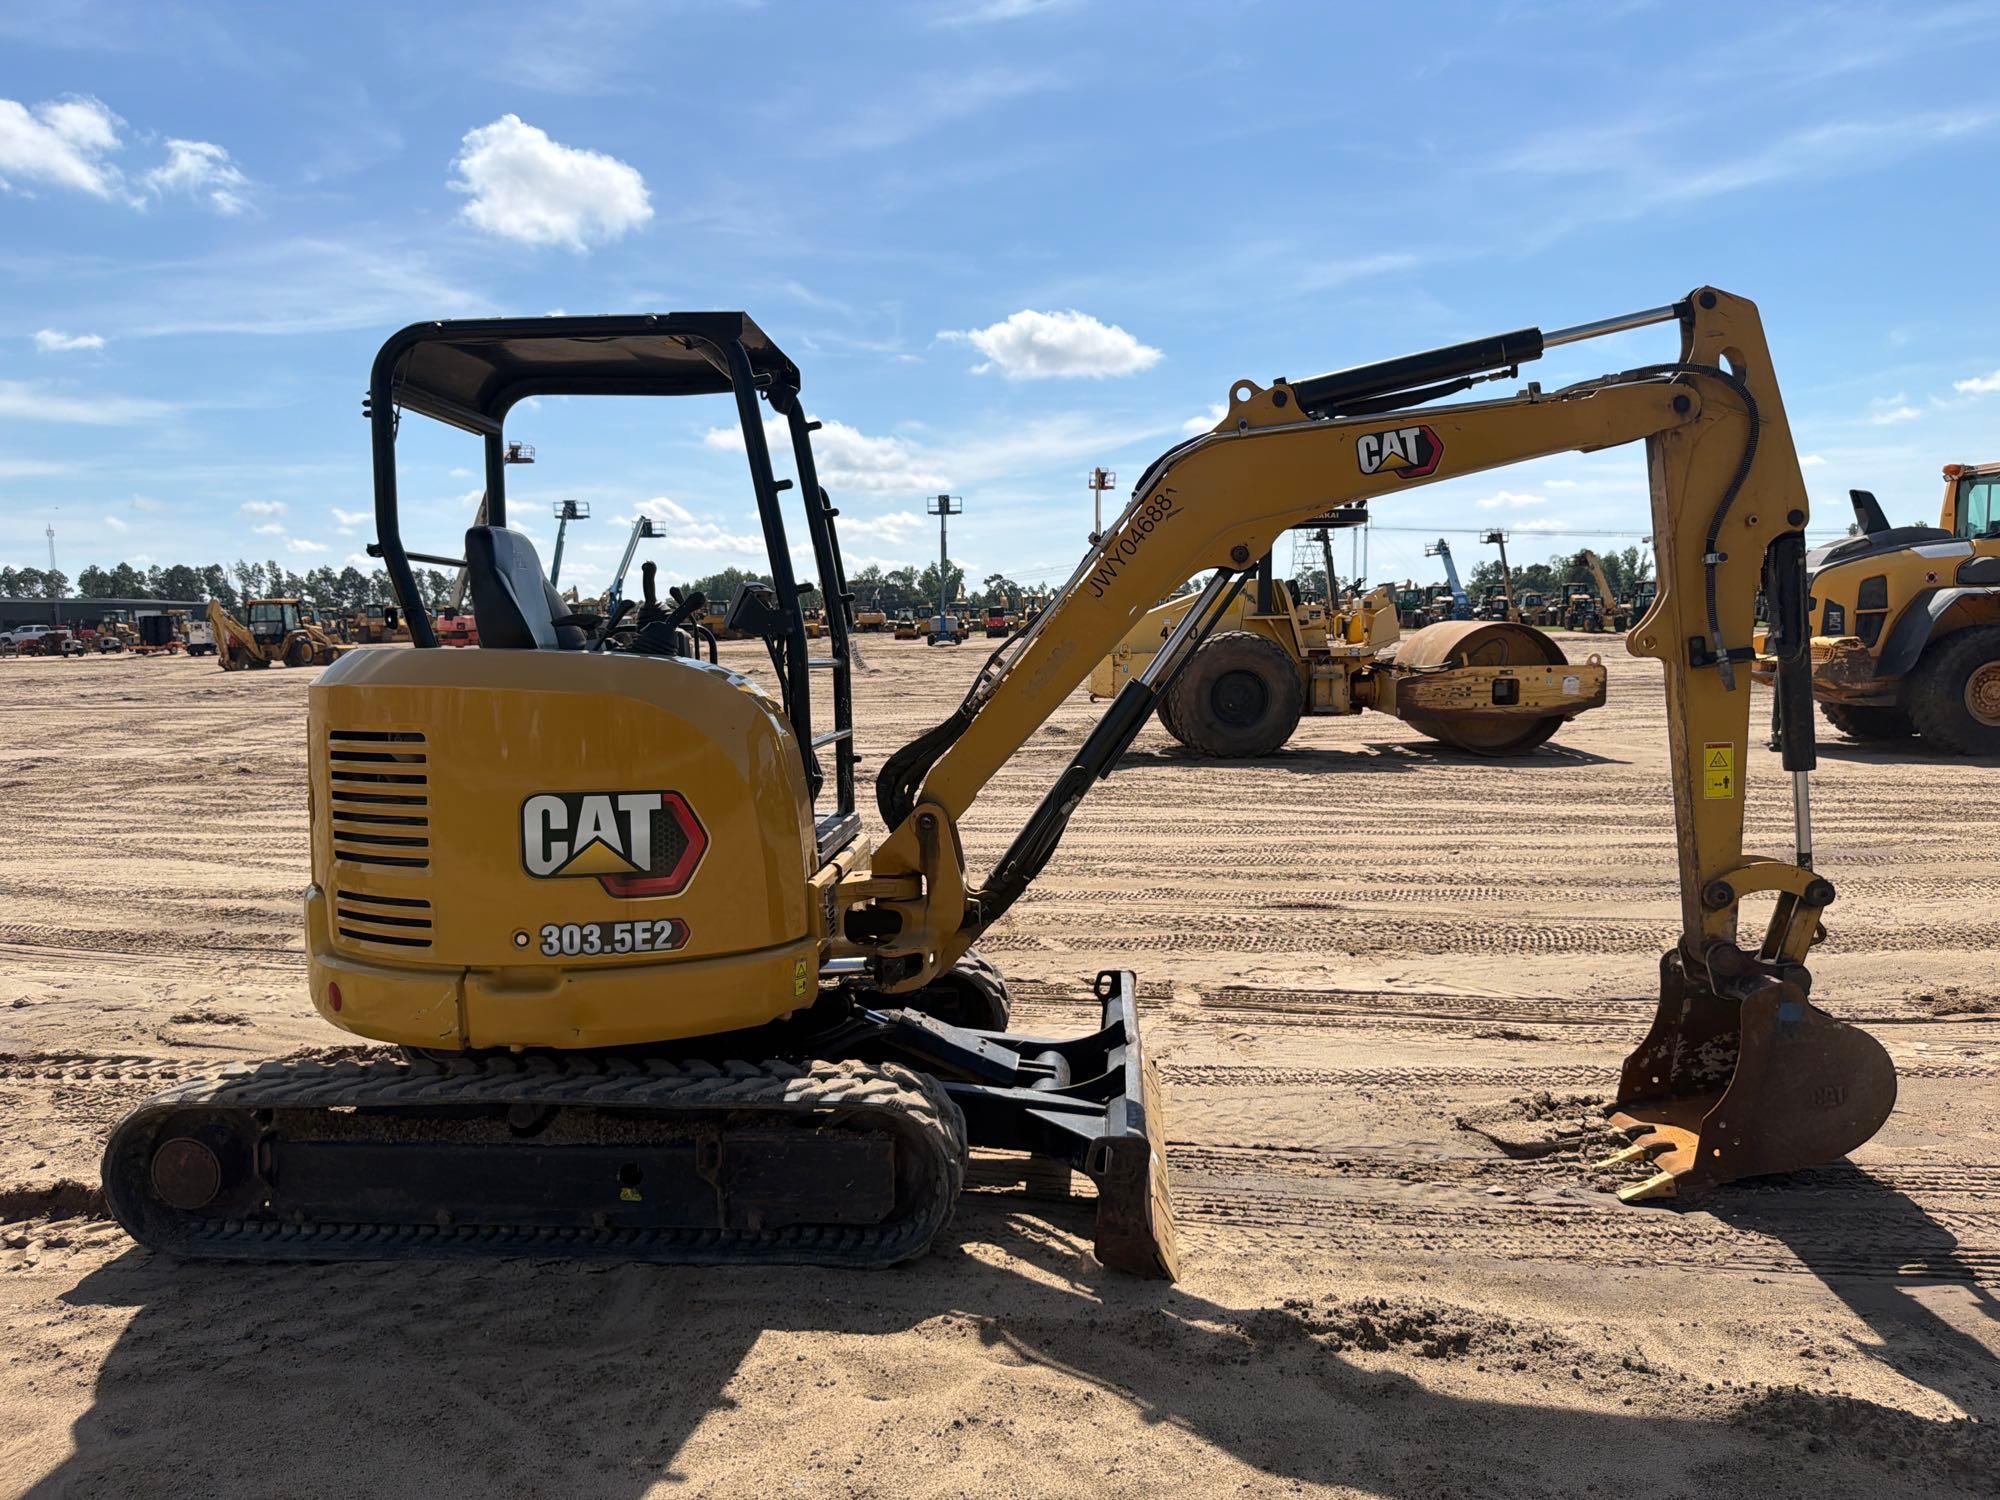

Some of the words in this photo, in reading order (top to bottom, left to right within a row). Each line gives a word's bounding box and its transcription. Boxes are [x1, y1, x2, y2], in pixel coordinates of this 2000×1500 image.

[1357, 427, 1420, 474] CAT
[1090, 487, 1177, 598] JWY046881
[523, 794, 662, 876] CAT
[541, 920, 673, 956] 303.5E2
